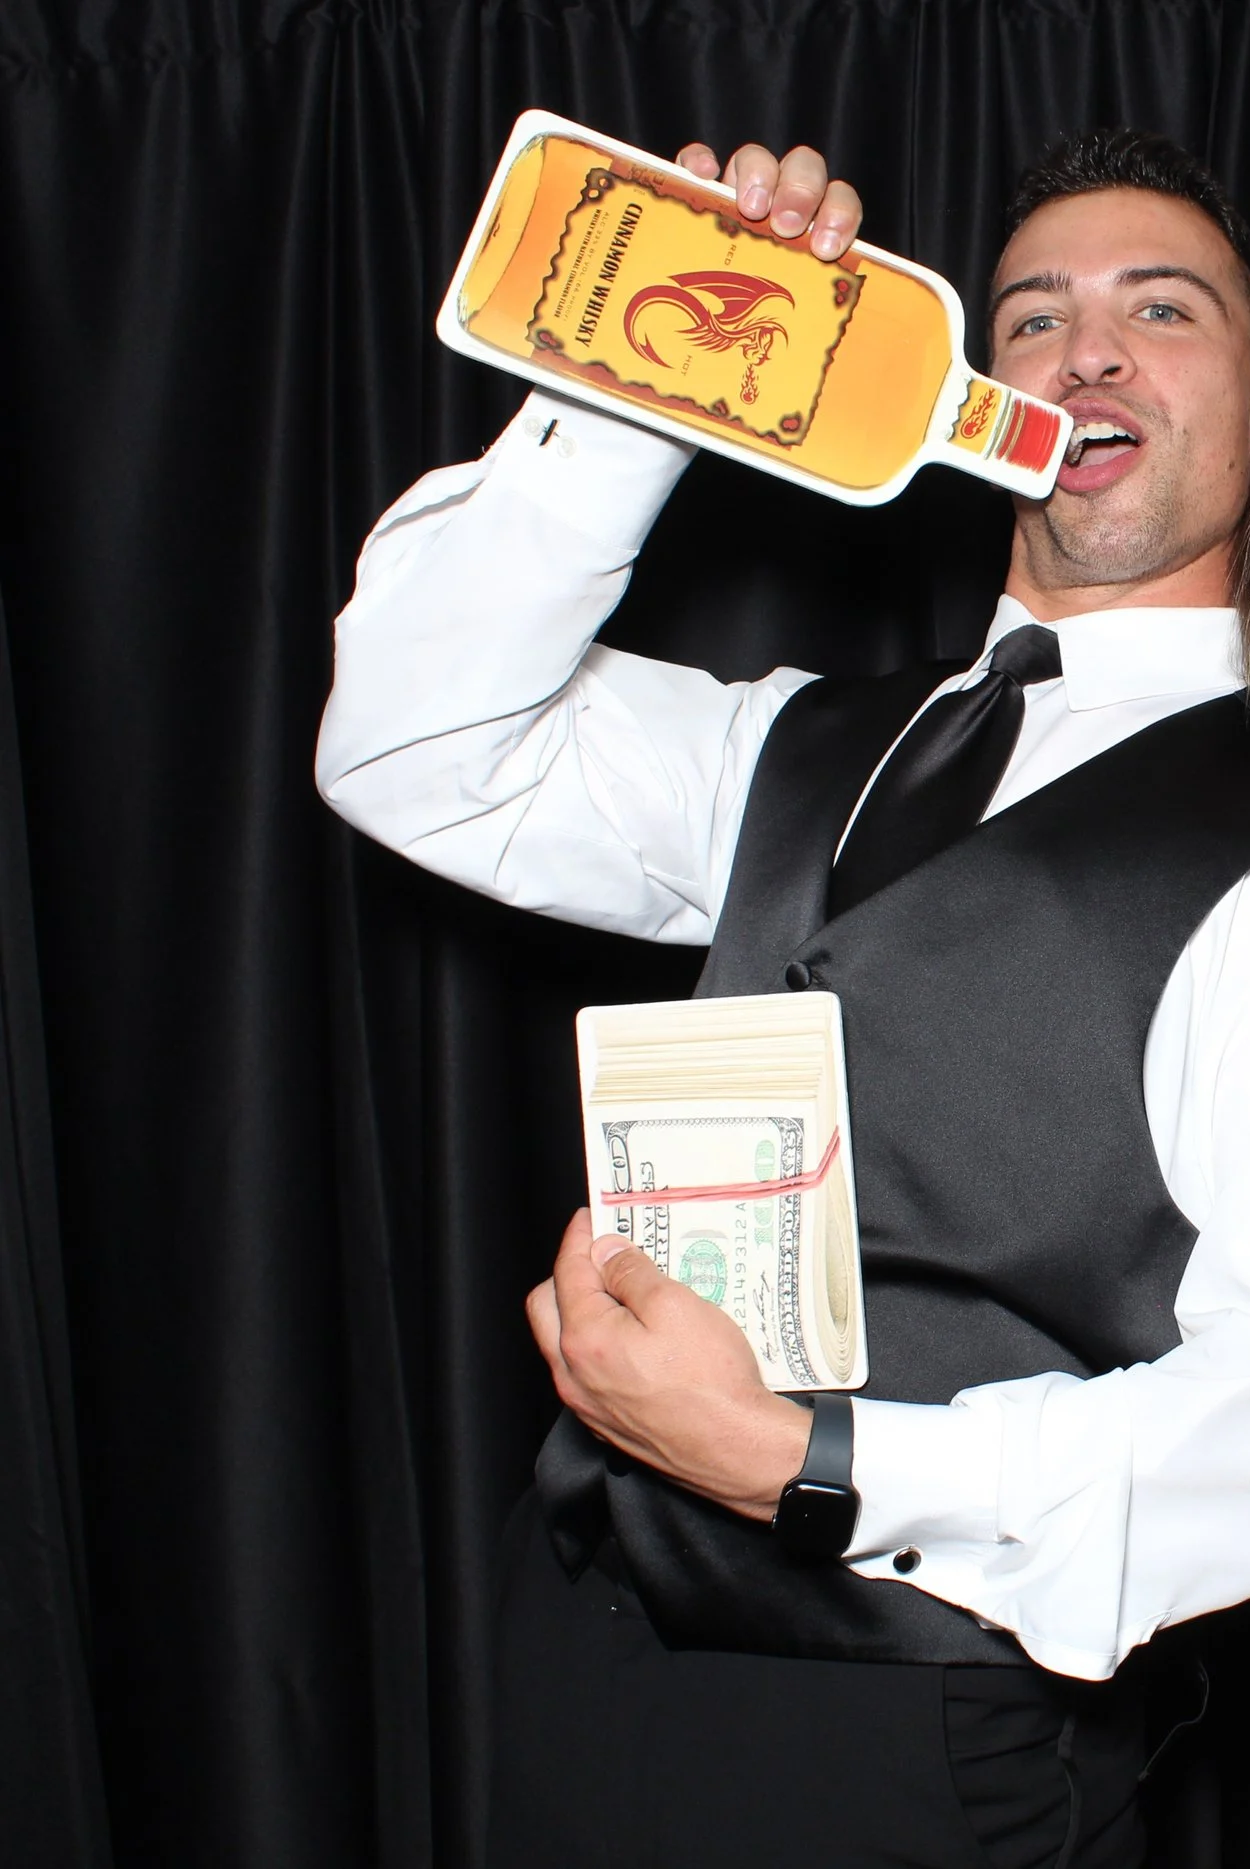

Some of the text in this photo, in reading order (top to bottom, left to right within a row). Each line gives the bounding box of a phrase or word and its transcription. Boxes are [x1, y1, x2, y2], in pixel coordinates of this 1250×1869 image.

[589, 208, 602, 230] WHISKY
[582, 230, 593, 246] WITH
[572, 245, 587, 271] NATURAL
[561, 269, 577, 298] CINNAMON
[575, 203, 643, 348] CINNAMON WHISKY
[681, 244, 736, 376] RED HOT
